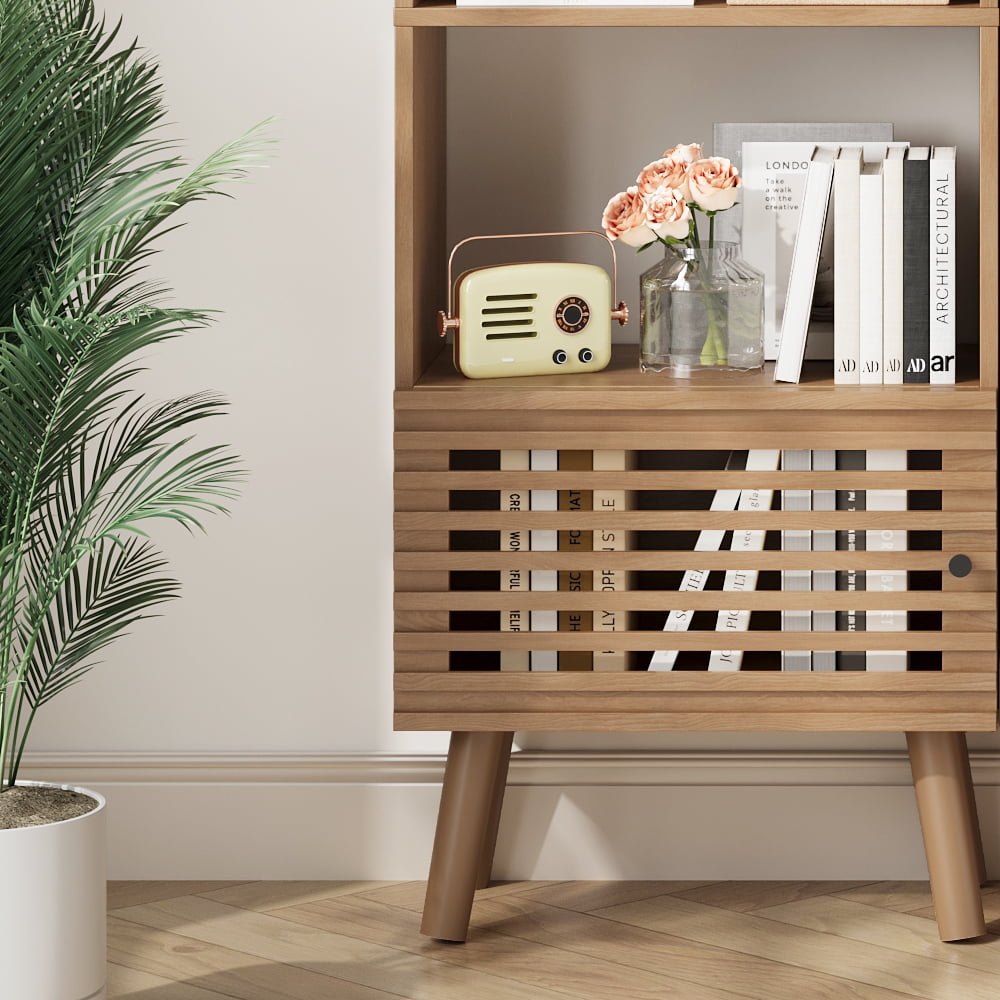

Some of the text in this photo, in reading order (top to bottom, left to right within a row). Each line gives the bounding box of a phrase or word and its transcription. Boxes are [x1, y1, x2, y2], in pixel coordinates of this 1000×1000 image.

[766, 161, 809, 170] LONDO
[936, 174, 949, 324] ARCHITECTURAL
[838, 360, 856, 373] AD
[863, 360, 879, 373] AD
[886, 358, 901, 372] AD
[907, 358, 926, 373] AD
[930, 354, 955, 372] ar
